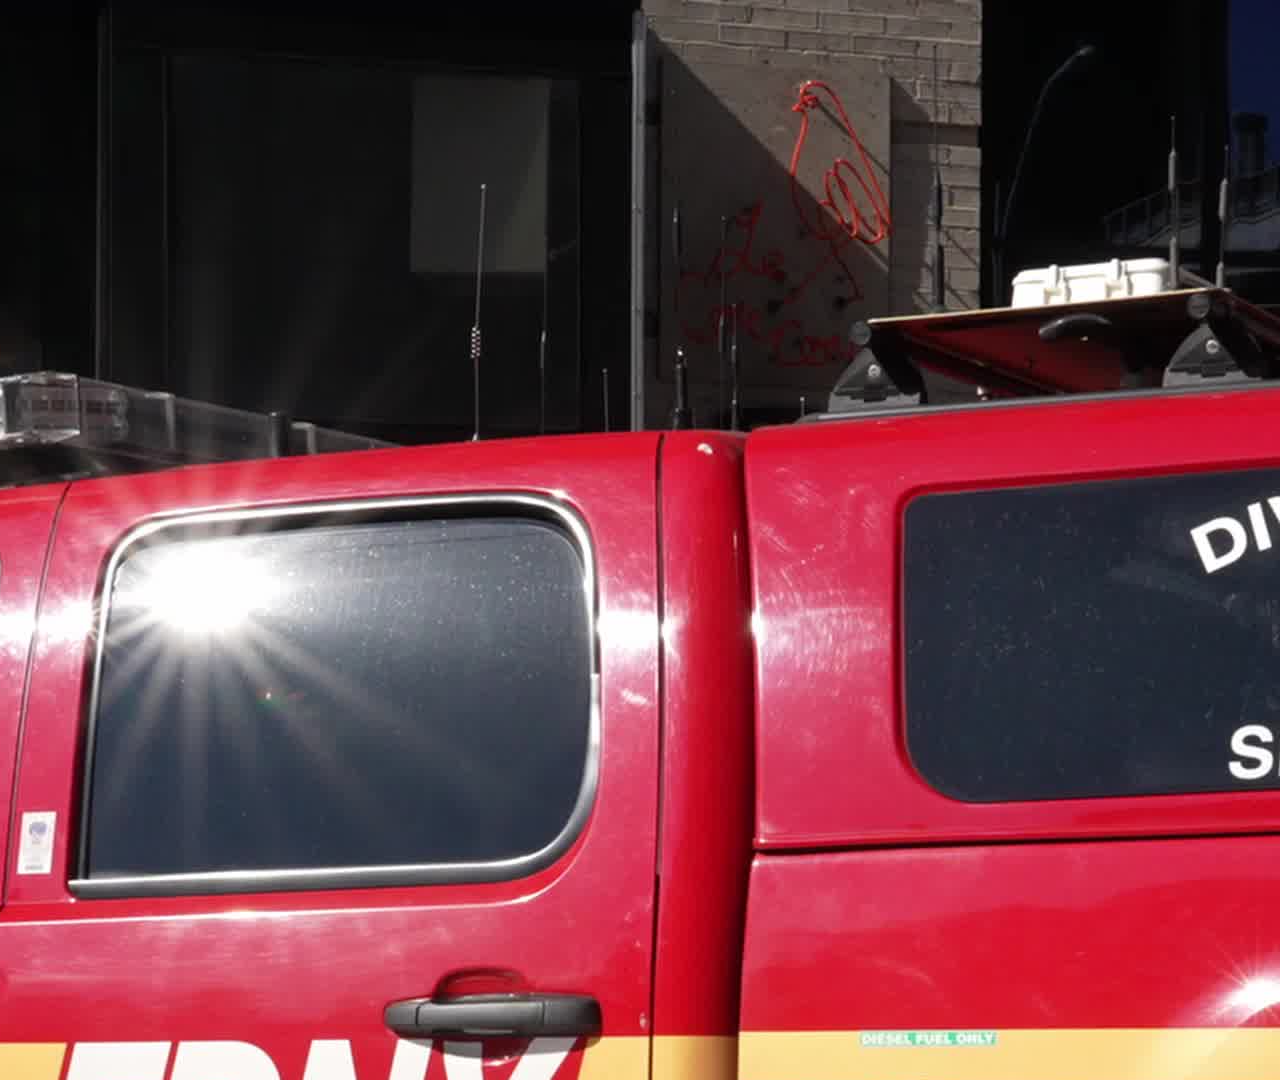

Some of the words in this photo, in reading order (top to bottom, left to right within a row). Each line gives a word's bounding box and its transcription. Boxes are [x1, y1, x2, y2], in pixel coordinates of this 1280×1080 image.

[862, 1032, 911, 1045] DIESEL
[916, 1032, 947, 1045] FUEL
[956, 1032, 996, 1045] ONLY
